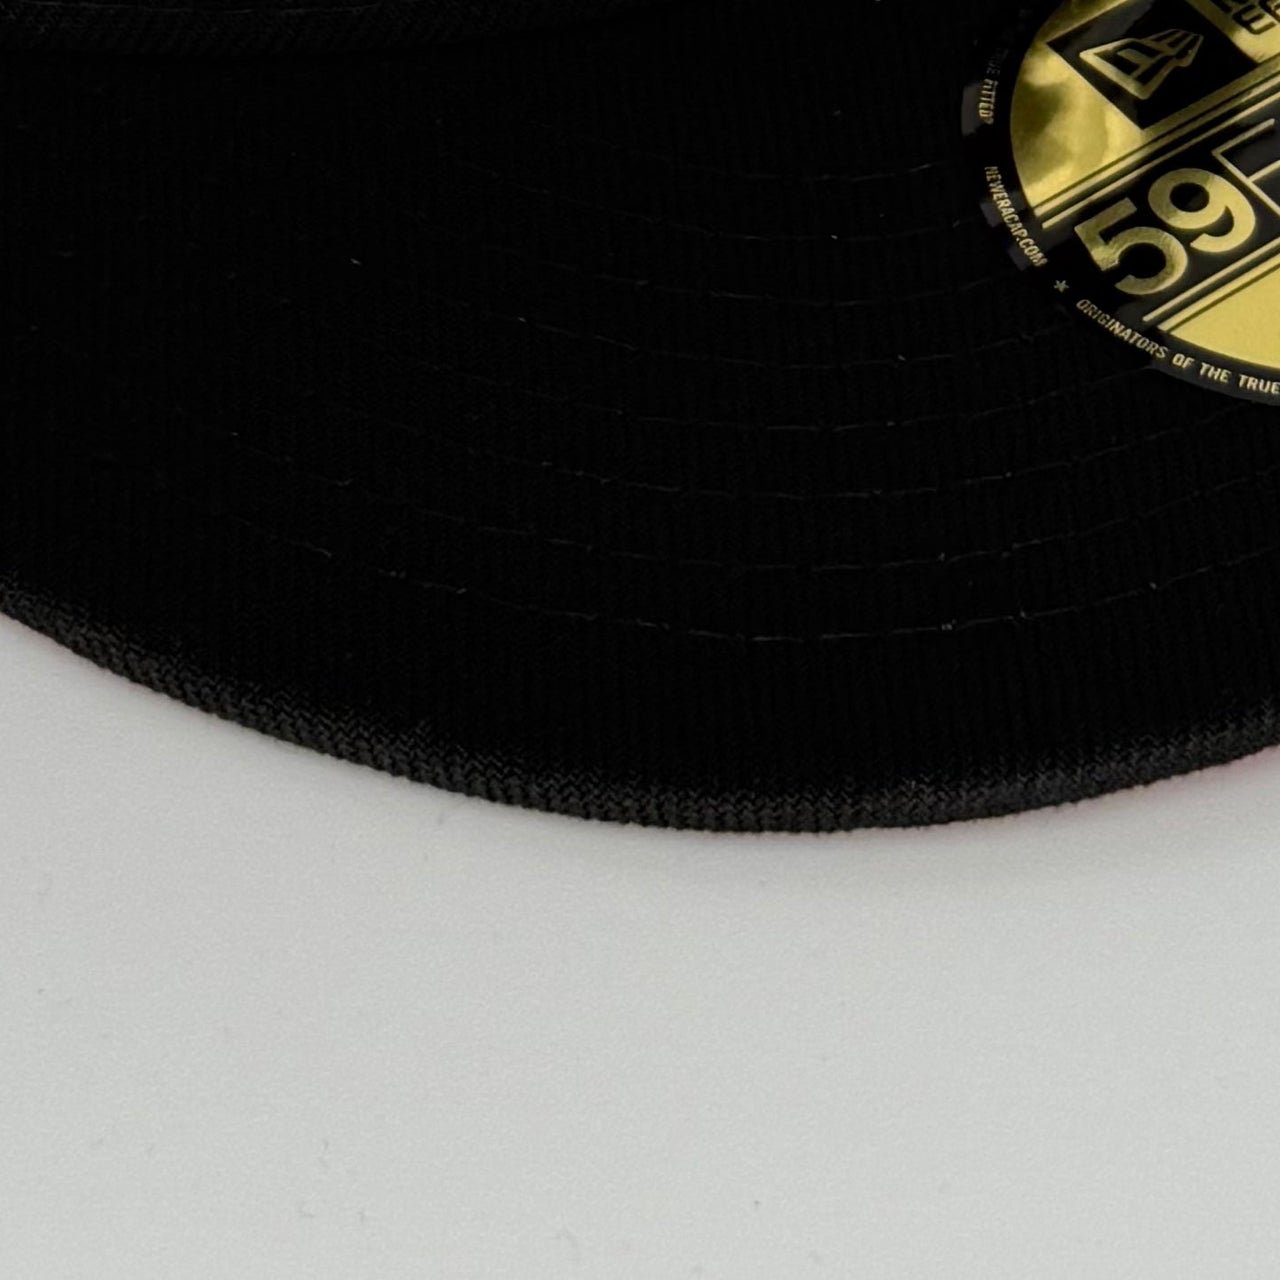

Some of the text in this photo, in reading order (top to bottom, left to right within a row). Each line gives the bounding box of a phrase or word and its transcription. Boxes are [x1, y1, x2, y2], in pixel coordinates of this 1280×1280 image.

[984, 166, 1048, 267] NEWERACAP.COM
[1075, 298, 1169, 359] ORIGINATORS
[1171, 352, 1195, 369] OF
[1199, 361, 1232, 383] THE
